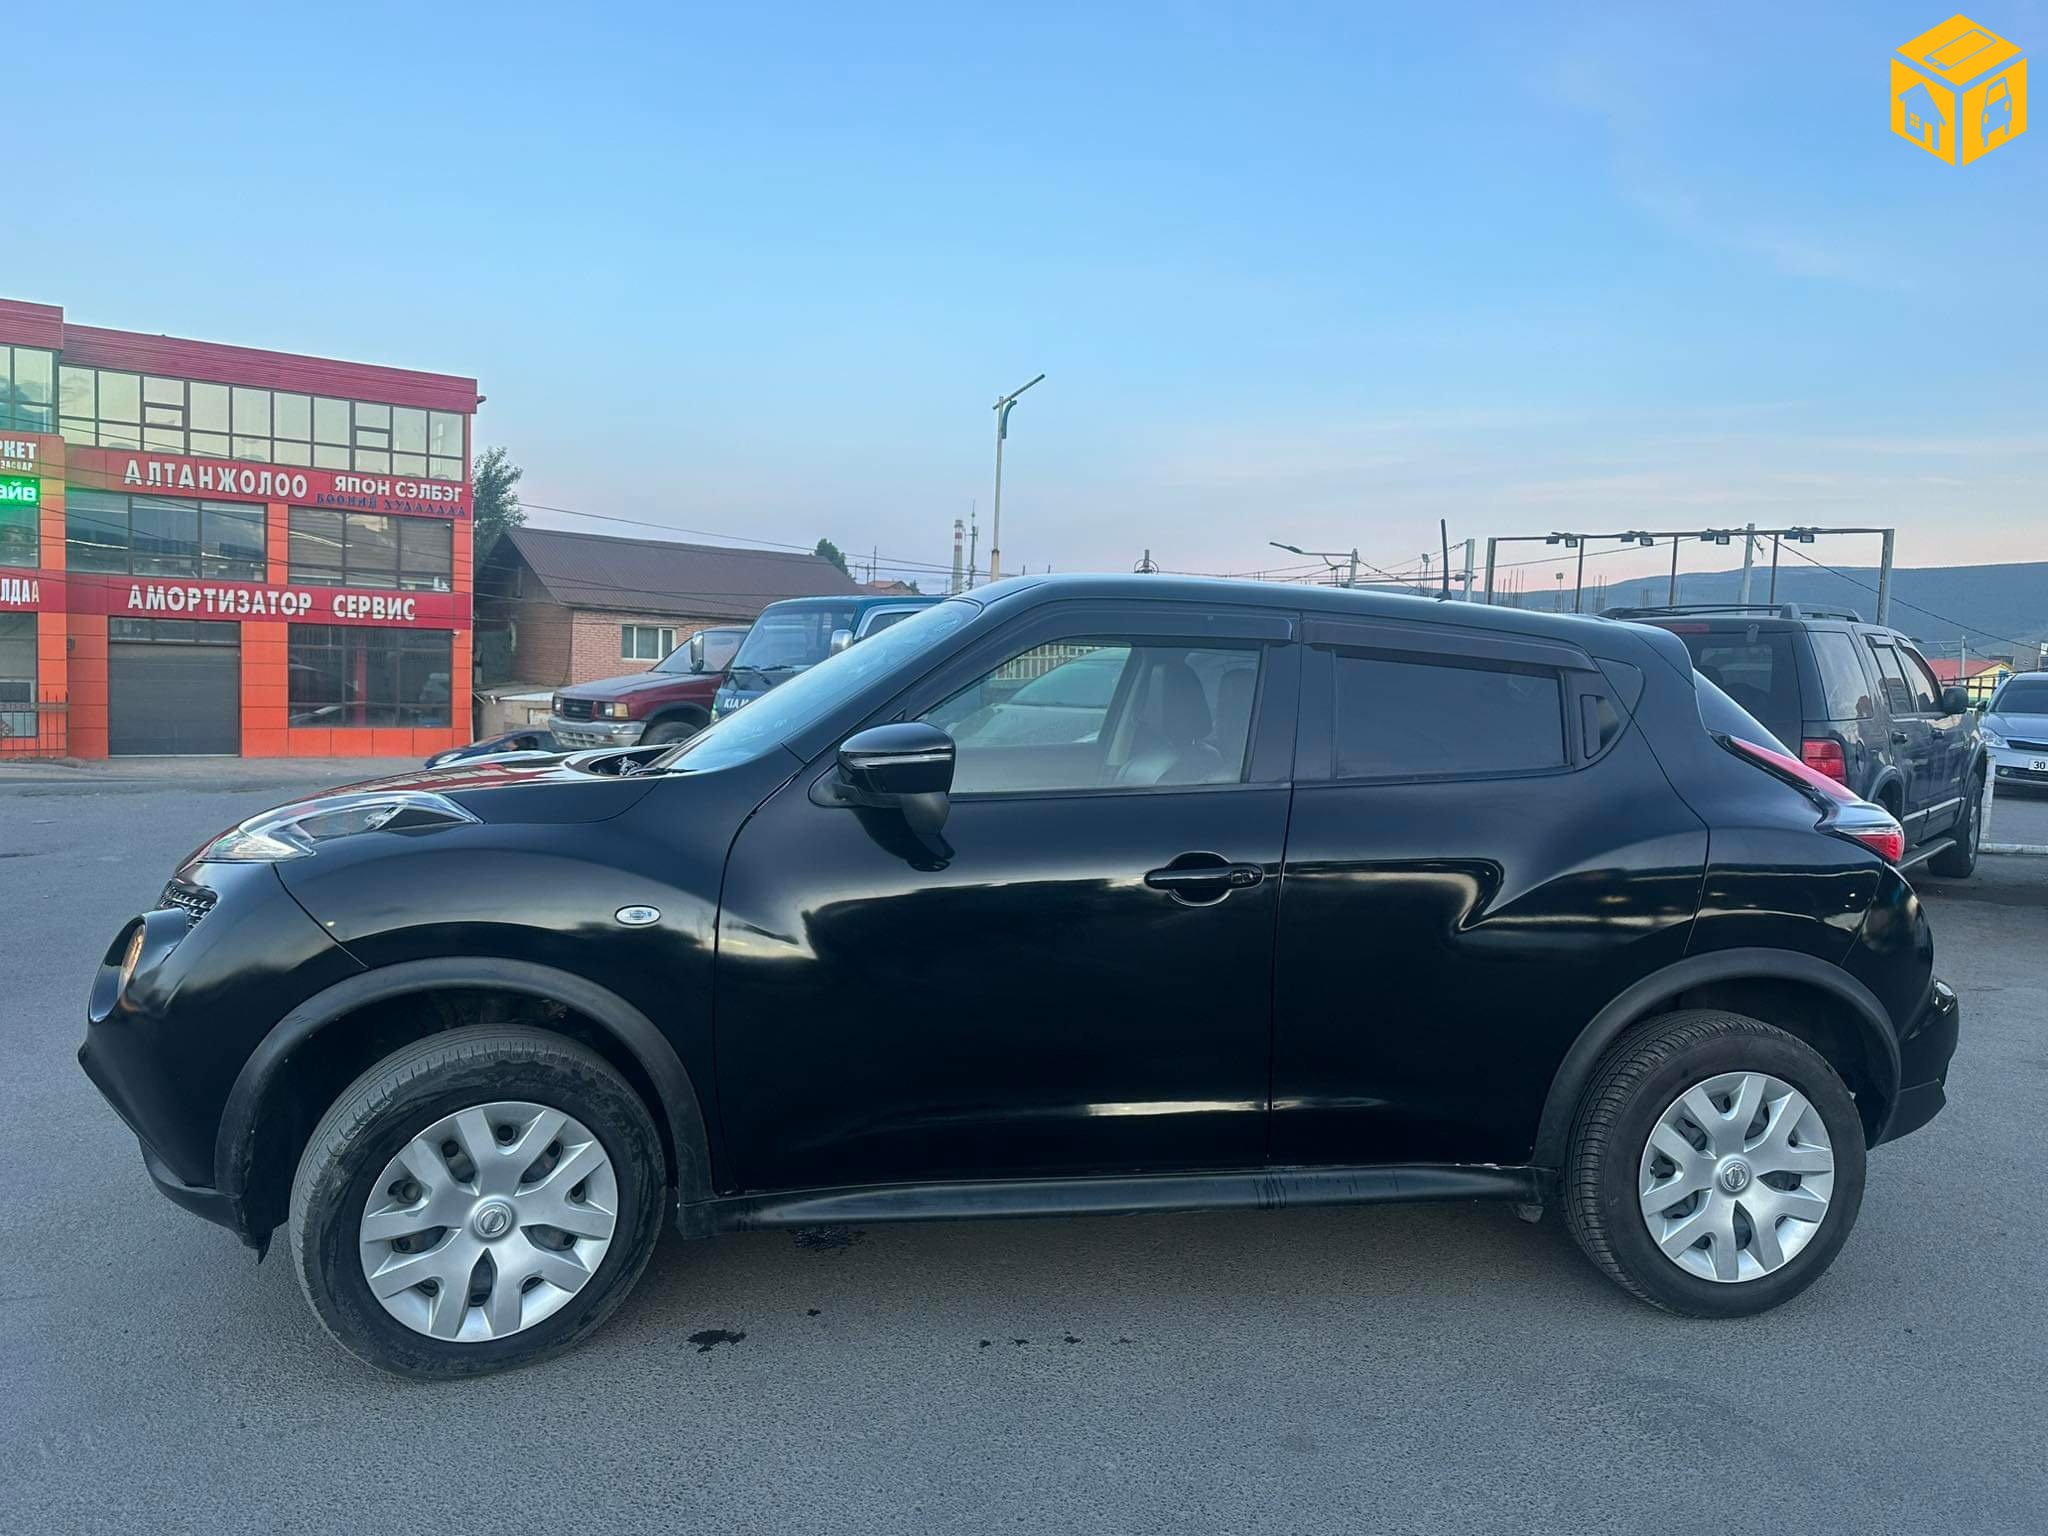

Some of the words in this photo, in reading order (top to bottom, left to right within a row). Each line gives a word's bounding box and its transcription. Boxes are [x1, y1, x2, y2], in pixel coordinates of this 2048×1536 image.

[124, 459, 307, 498] АЛТАНЖОЛОО
[335, 475, 390, 496] ЯПОН
[395, 481, 463, 502] СЭЛБЭГ
[128, 584, 313, 616] АМОРТИЗАТОР
[333, 594, 416, 621] СЕРВИС
[723, 697, 739, 709] KIA
